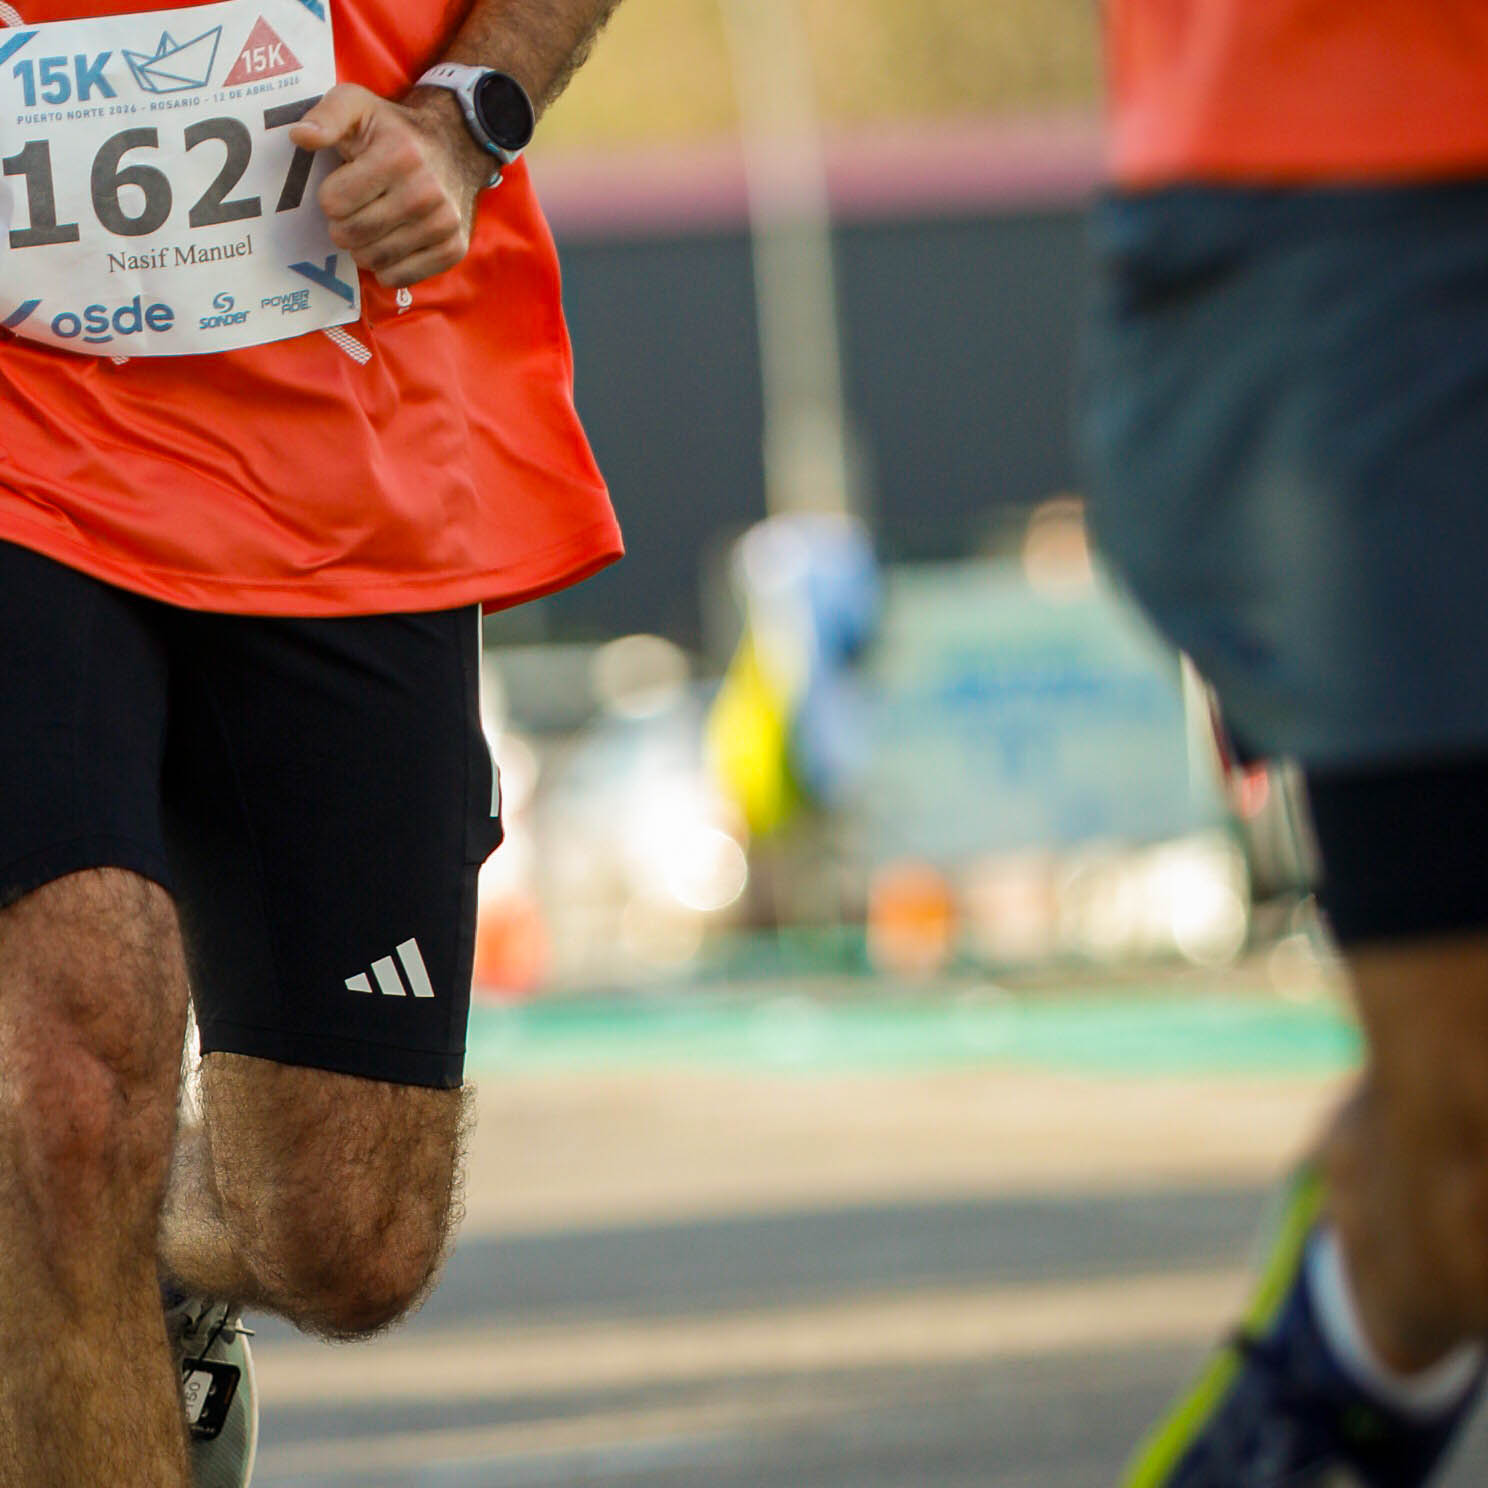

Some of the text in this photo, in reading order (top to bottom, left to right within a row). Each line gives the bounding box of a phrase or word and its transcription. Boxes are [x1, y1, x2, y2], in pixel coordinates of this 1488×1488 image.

[13, 51, 118, 107] 15K
[241, 42, 285, 74] 15K
[17, 112, 63, 125] PUERTO
[67, 108, 105, 120] NORTE
[150, 97, 200, 112] ROSARIO
[214, 93, 225, 103] 12
[229, 90, 242, 100] DE
[246, 83, 275, 97] ABRIL
[2, 95, 324, 250] 1627
[106, 234, 253, 273] Nasif Manuel
[51, 294, 175, 339] osde
[261, 288, 310, 309] POWER
